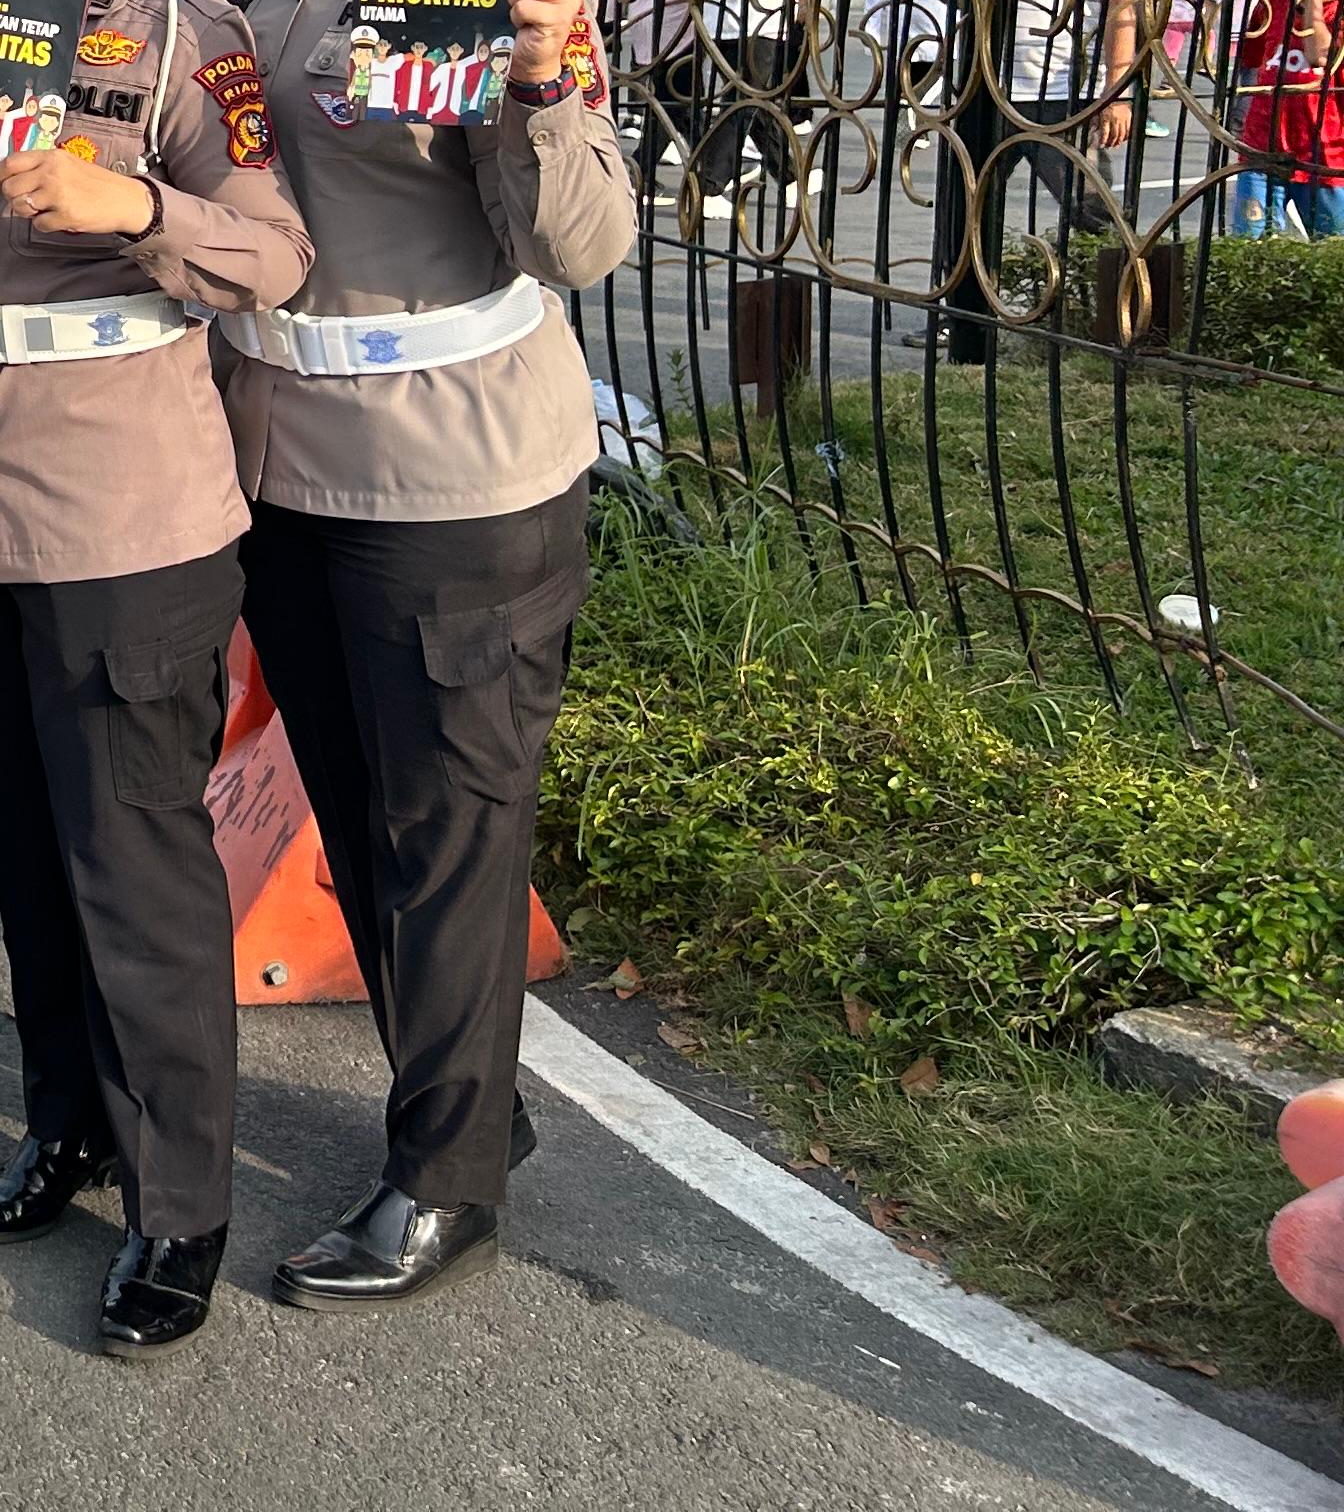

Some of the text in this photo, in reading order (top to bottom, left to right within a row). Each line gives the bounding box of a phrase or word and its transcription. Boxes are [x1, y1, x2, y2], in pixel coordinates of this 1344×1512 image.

[360, 6, 406, 23] UTAMA
[20, 18, 60, 39] TETAP
[203, 55, 254, 84] POLDA
[223, 81, 259, 101] RIAU
